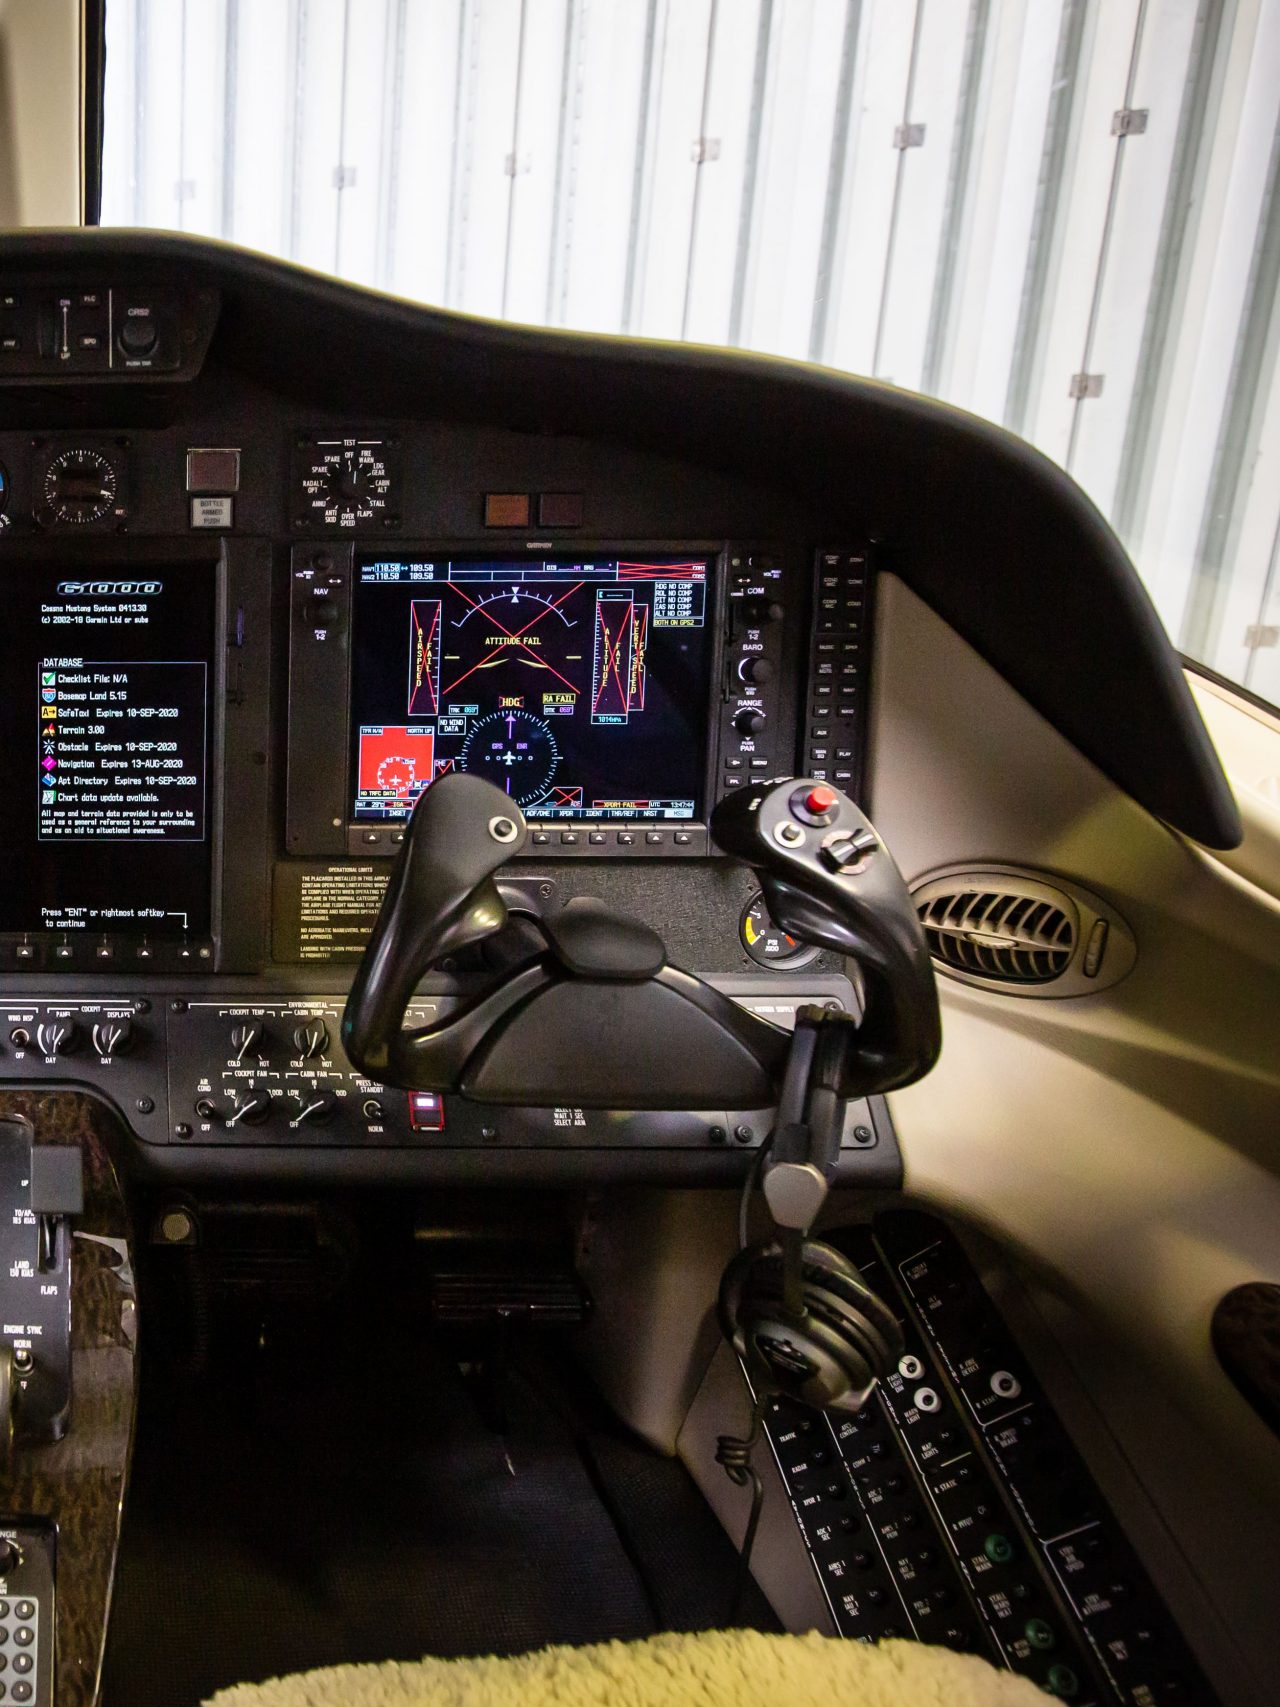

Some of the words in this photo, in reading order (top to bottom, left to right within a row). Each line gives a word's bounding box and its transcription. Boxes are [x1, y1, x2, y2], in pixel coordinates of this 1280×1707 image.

[58, 582, 161, 595] G1000
[42, 604, 63, 612] Cessna
[66, 604, 91, 612] Mustang
[93, 604, 116, 612] System
[119, 604, 147, 612] 0413.30
[42, 616, 50, 624] (c)
[53, 616, 83, 624] 2002-18
[86, 616, 107, 624] Garmin
[110, 616, 122, 624] Ltd
[125, 616, 132, 624] or
[135, 616, 148, 624] subs
[485, 637, 520, 645] ATTITUDE
[524, 637, 541, 645] FAIL
[43, 658, 83, 667] DATABASE
[58, 674, 91, 683] Checklist
[94, 674, 110, 683] File:
[113, 674, 128, 683] N/A
[58, 691, 87, 700] Basemap
[90, 691, 106, 700] Land
[110, 691, 127, 700] 5.15
[544, 694, 553, 702] RA
[556, 694, 573, 702] FAIL
[502, 697, 520, 707] HDG
[58, 708, 89, 718] SafeTaxi
[96, 708, 123, 718] Expires
[127, 708, 178, 718] 10-SEP-2020
[58, 726, 85, 734] Terrain
[88, 726, 105, 734] 3.00
[58, 742, 88, 751] Obstacle
[95, 742, 122, 751] Expires
[126, 742, 177, 751] 10-SEP-2020
[58, 760, 95, 769] Navigation
[101, 760, 128, 769] Expires
[132, 760, 183, 769] 13-AUG-2020
[58, 776, 71, 785] Apt
[74, 776, 108, 785] Directory
[115, 776, 142, 785] Expires
[145, 776, 197, 785] 10-SEP-2020
[58, 793, 78, 802] Chart
[82, 793, 97, 802] data
[100, 793, 123, 802] update
[127, 793, 159, 802] available.
[41, 908, 62, 917] Press
[65, 908, 87, 917] "ENT"
[90, 908, 99, 917] or
[101, 908, 134, 917] rightmost
[137, 908, 164, 917] softkey
[46, 920, 54, 928] to
[56, 920, 85, 928] continue
[41, 1286, 57, 1295] FLAPS
[4, 1325, 24, 1334] ENGINE
[27, 1326, 42, 1335] SYNC
[779, 1432, 796, 1442] TRAFFIC
[792, 1463, 808, 1473] RADAR
